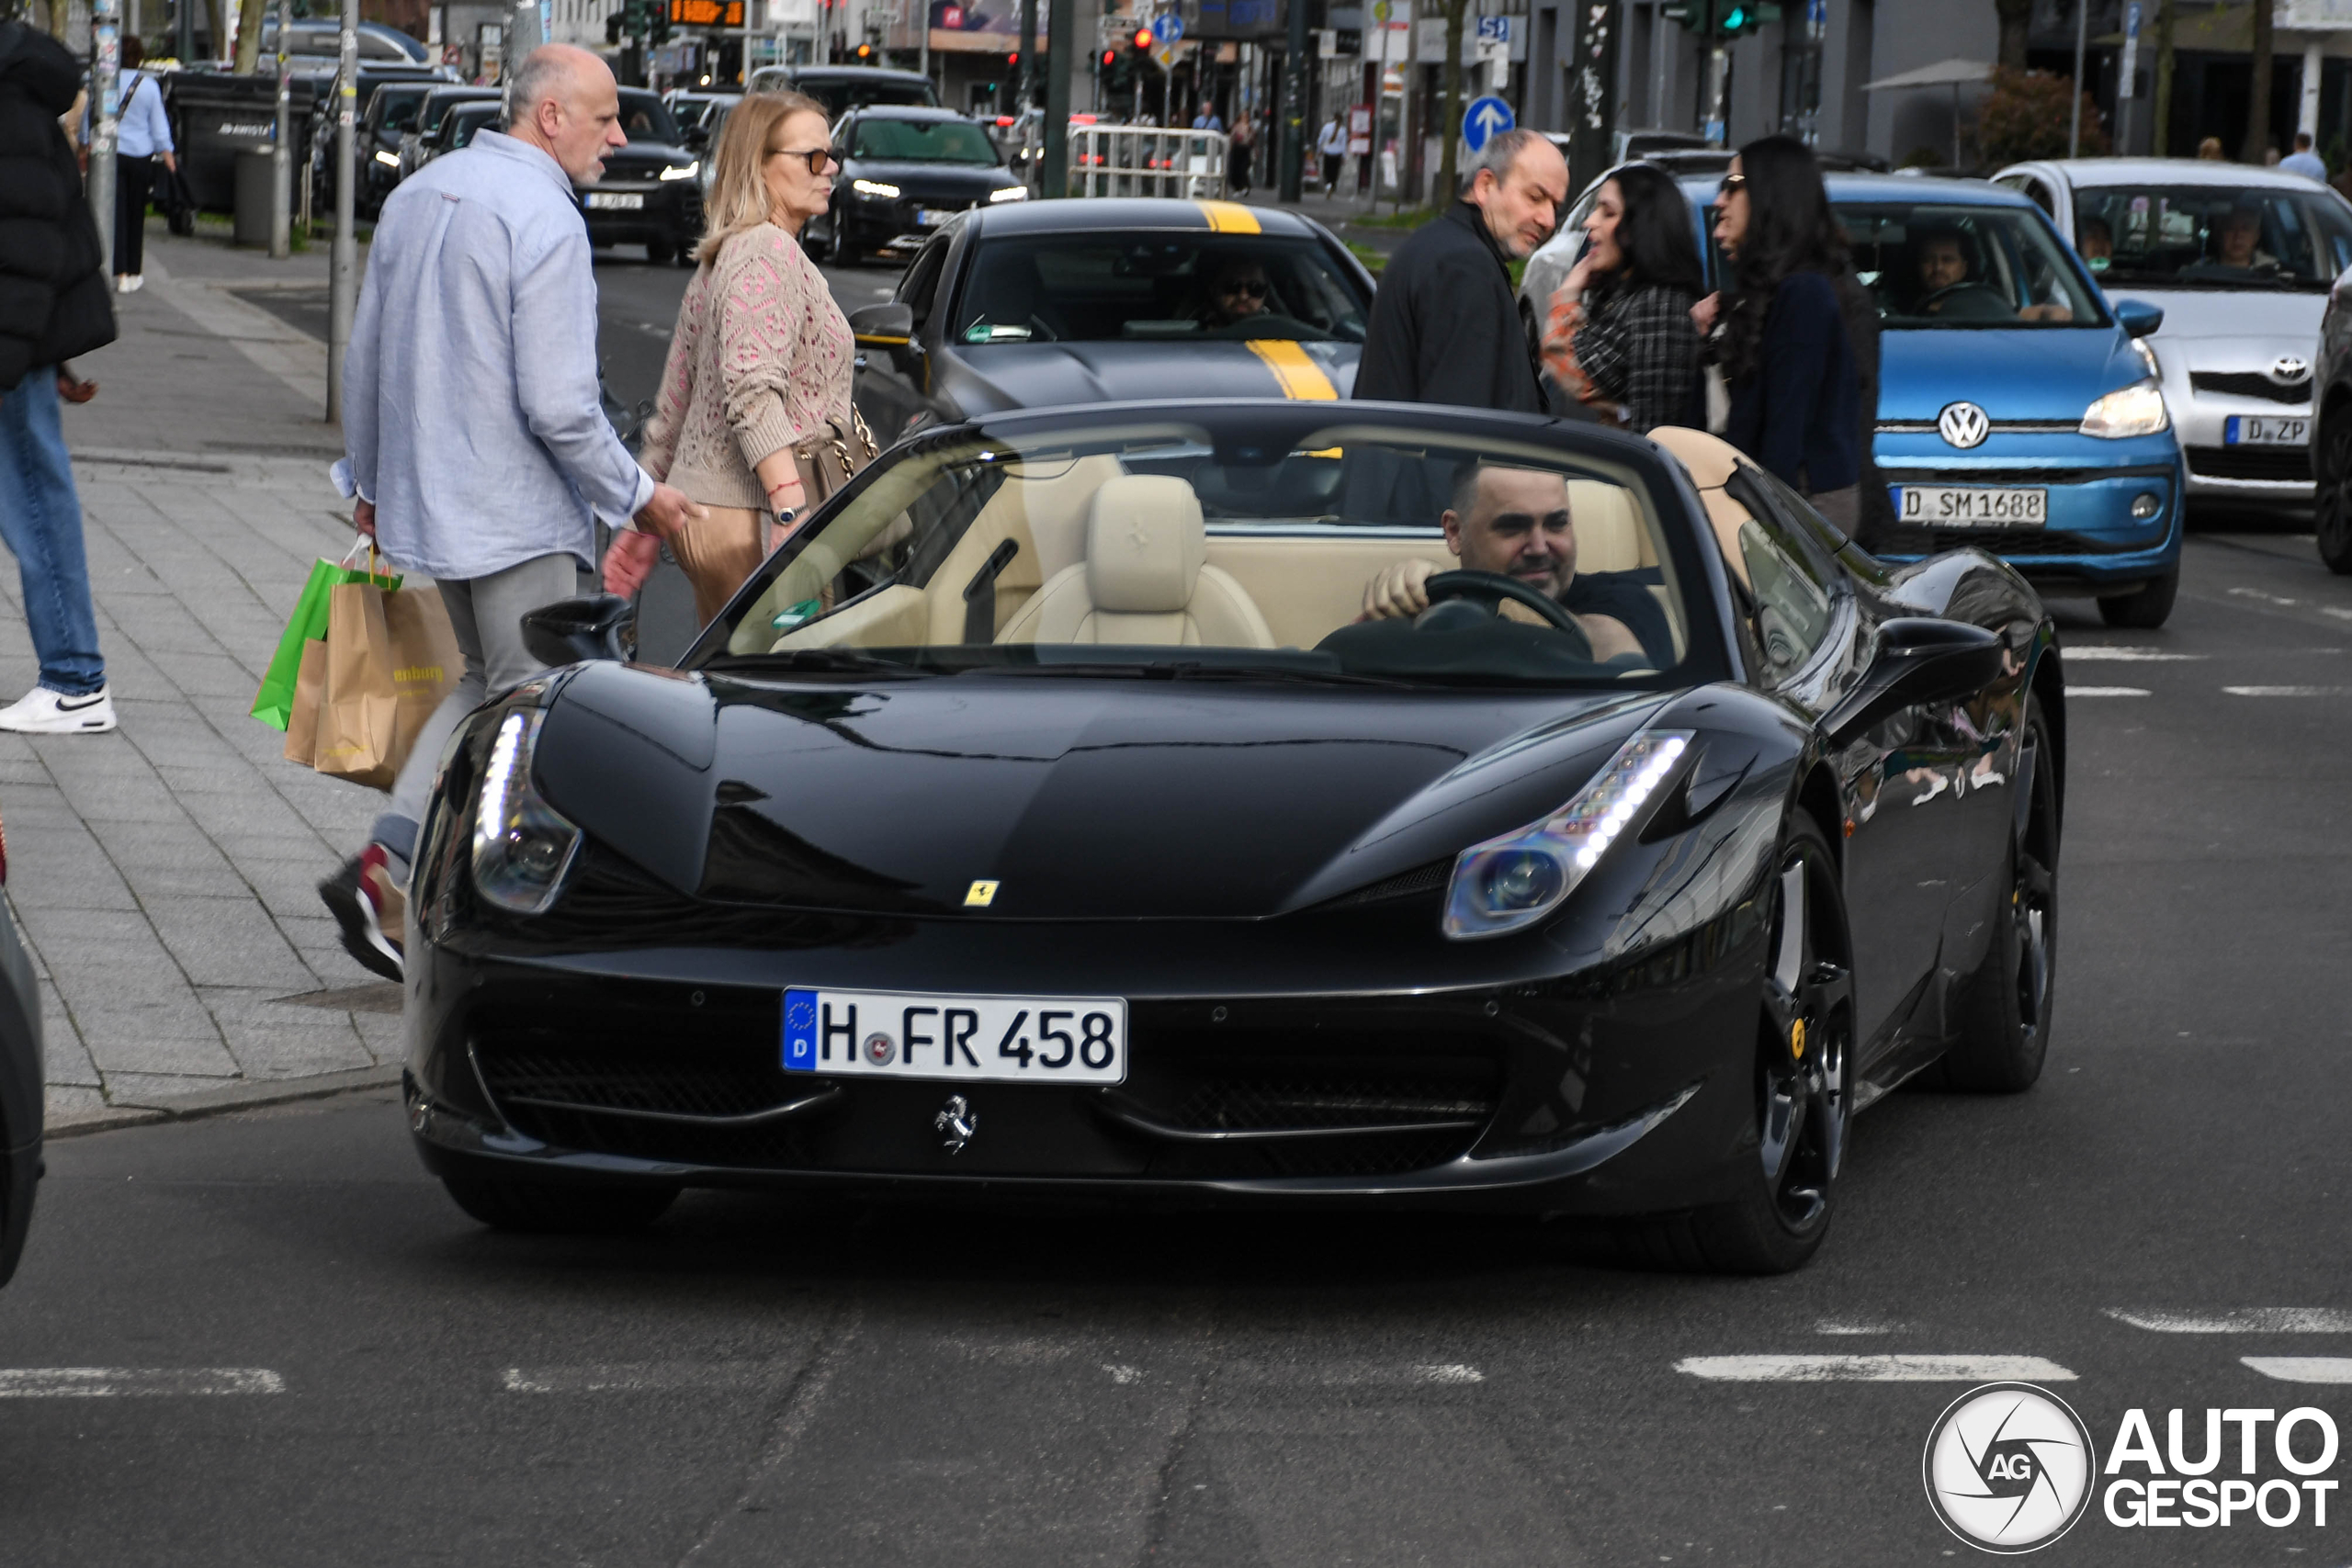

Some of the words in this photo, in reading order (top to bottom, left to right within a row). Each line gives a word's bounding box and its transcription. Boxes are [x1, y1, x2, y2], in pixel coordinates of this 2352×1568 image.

[2249, 420, 2262, 439] D
[1905, 491, 1921, 515] D
[1939, 491, 1972, 517] SM
[1977, 493, 2041, 518] 1688
[822, 1002, 857, 1062] H
[903, 1007, 982, 1067] FR
[999, 1009, 1114, 1069] 458
[794, 1039, 807, 1057] D
